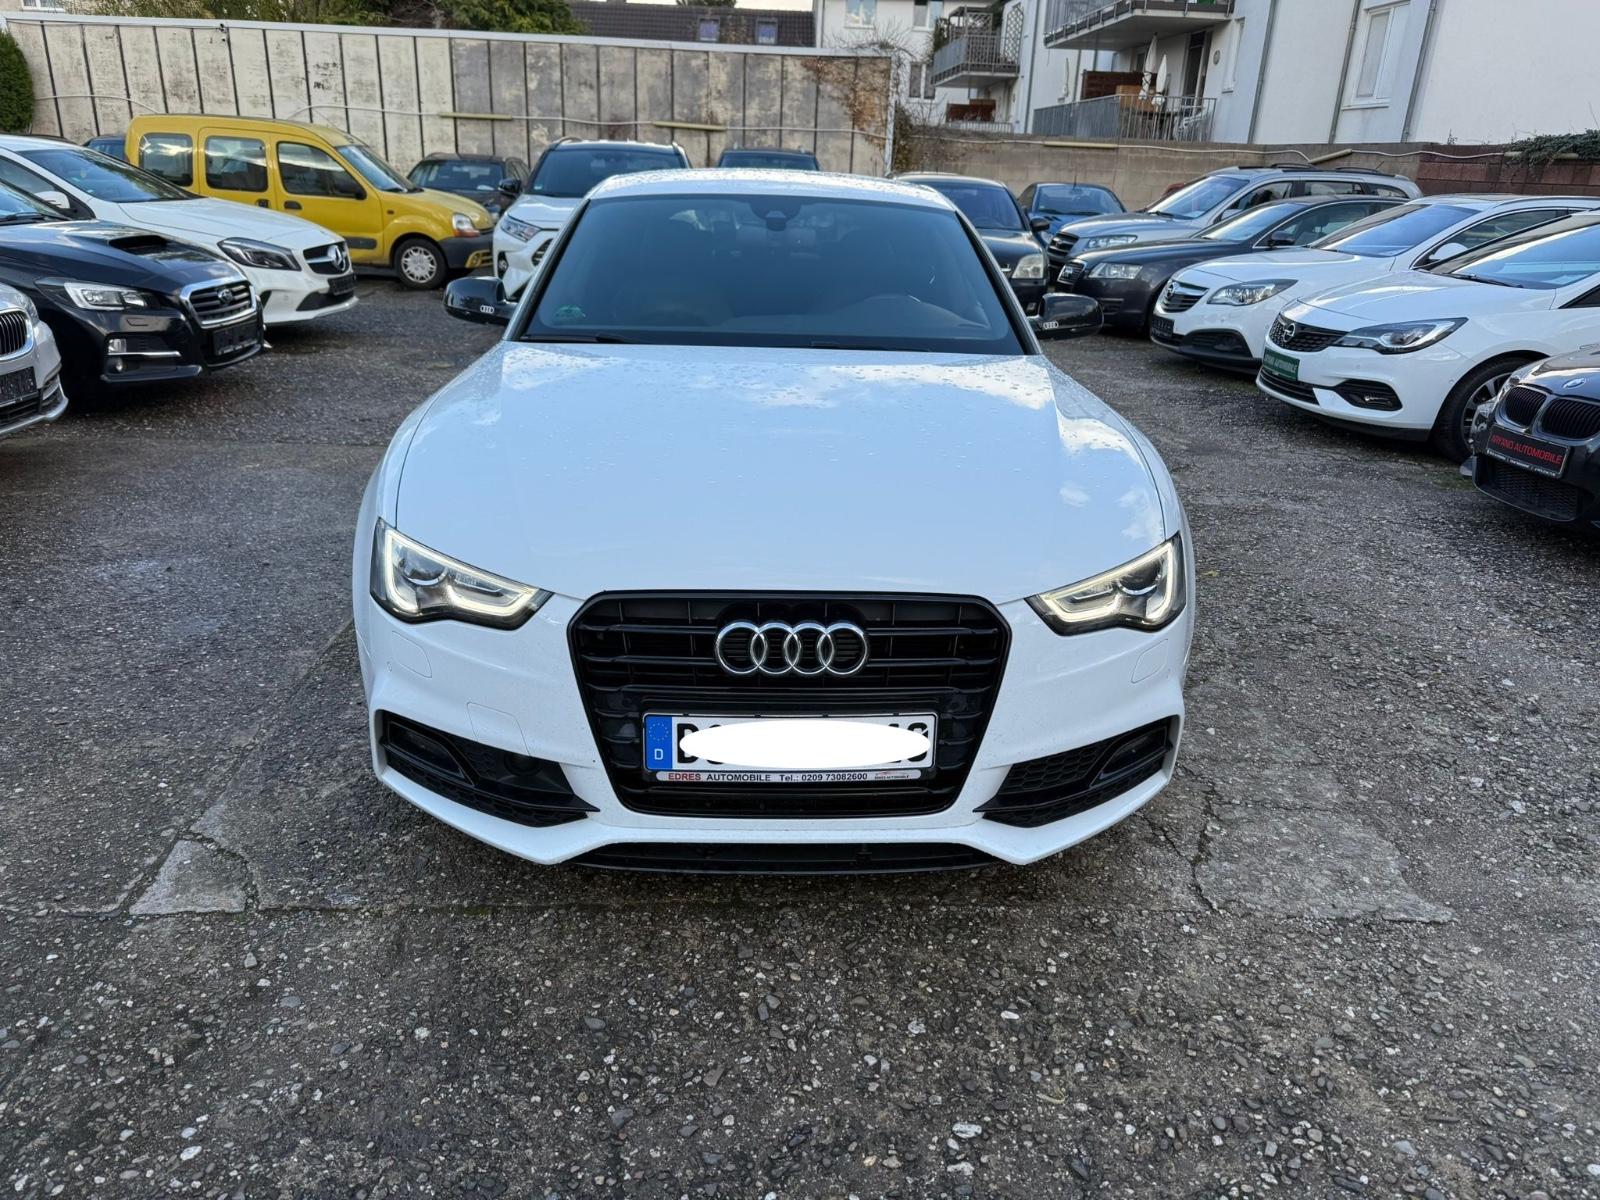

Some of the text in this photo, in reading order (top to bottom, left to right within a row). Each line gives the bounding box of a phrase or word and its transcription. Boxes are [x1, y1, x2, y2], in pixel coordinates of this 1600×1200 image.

[1514, 442, 1563, 464] AUTOMOBILE
[654, 748, 664, 760] D
[667, 772, 701, 781] EDRES
[706, 773, 772, 782] AUTOMOBILE
[779, 774, 799, 782] Tel.:
[801, 774, 823, 782] 0209
[825, 772, 868, 781] 73082600
